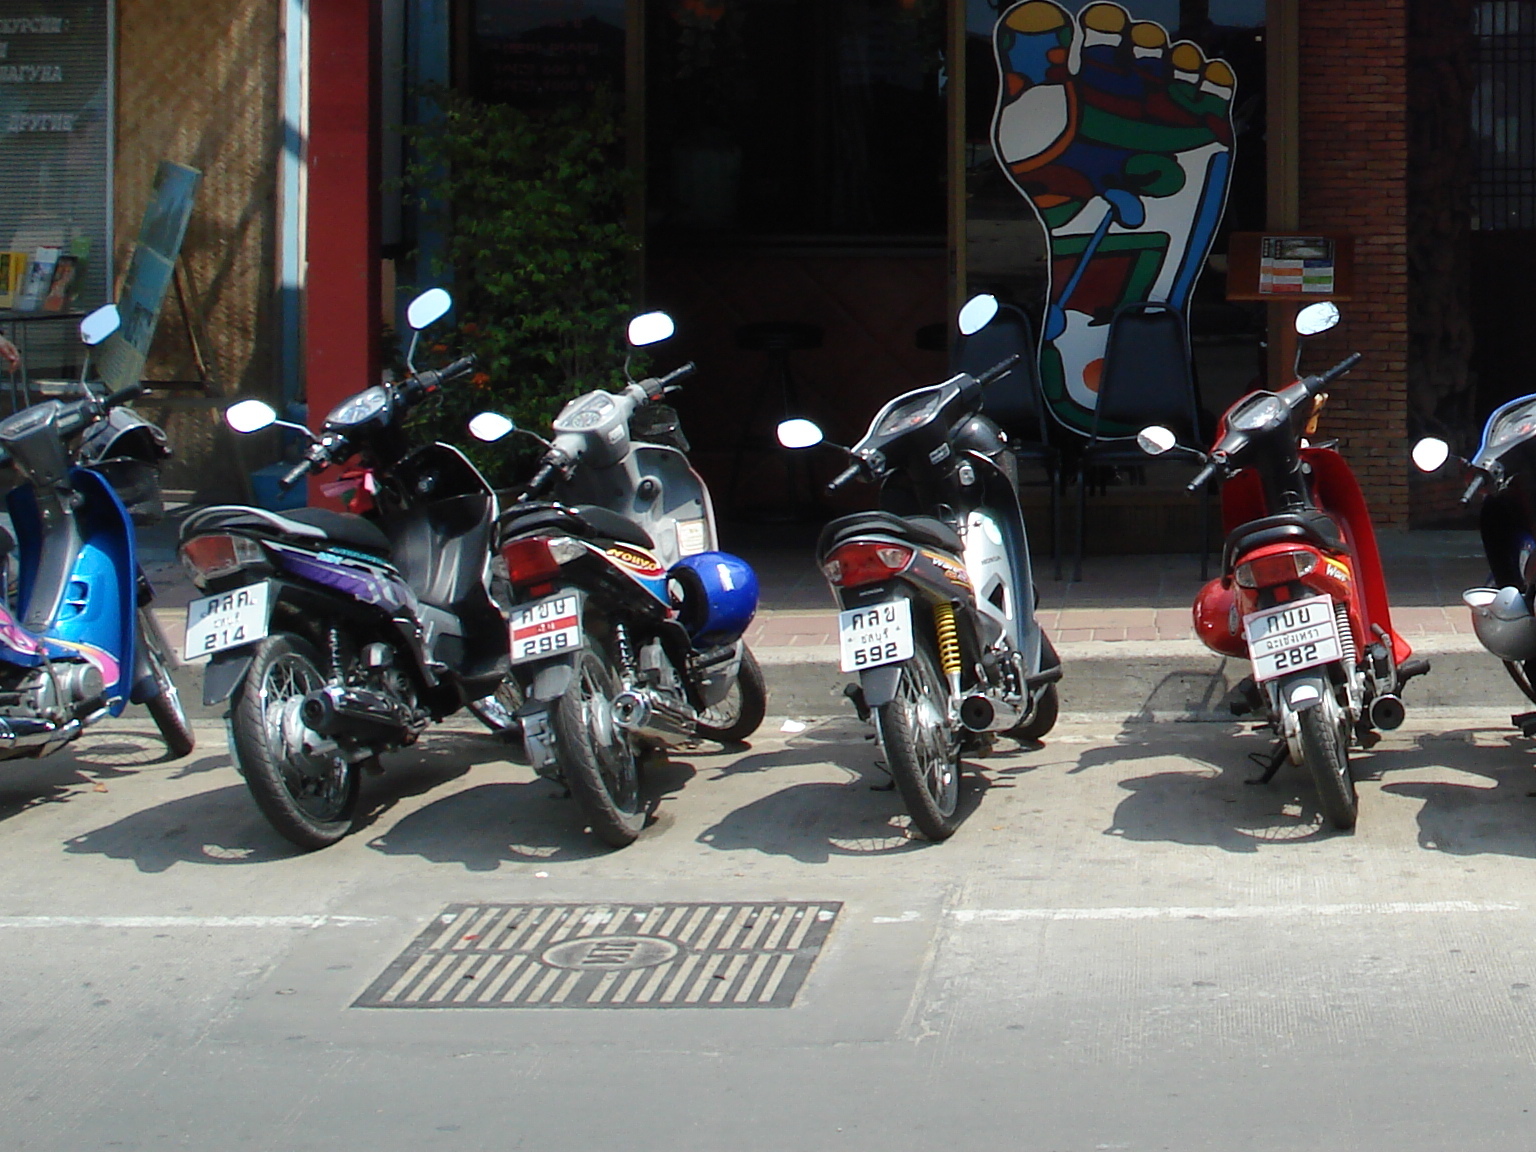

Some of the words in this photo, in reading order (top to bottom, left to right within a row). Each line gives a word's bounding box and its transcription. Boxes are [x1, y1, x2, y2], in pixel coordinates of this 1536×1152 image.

[204, 625, 245, 650] 214
[523, 632, 568, 658] 299
[854, 642, 898, 666] 592
[1274, 643, 1318, 670] 282
